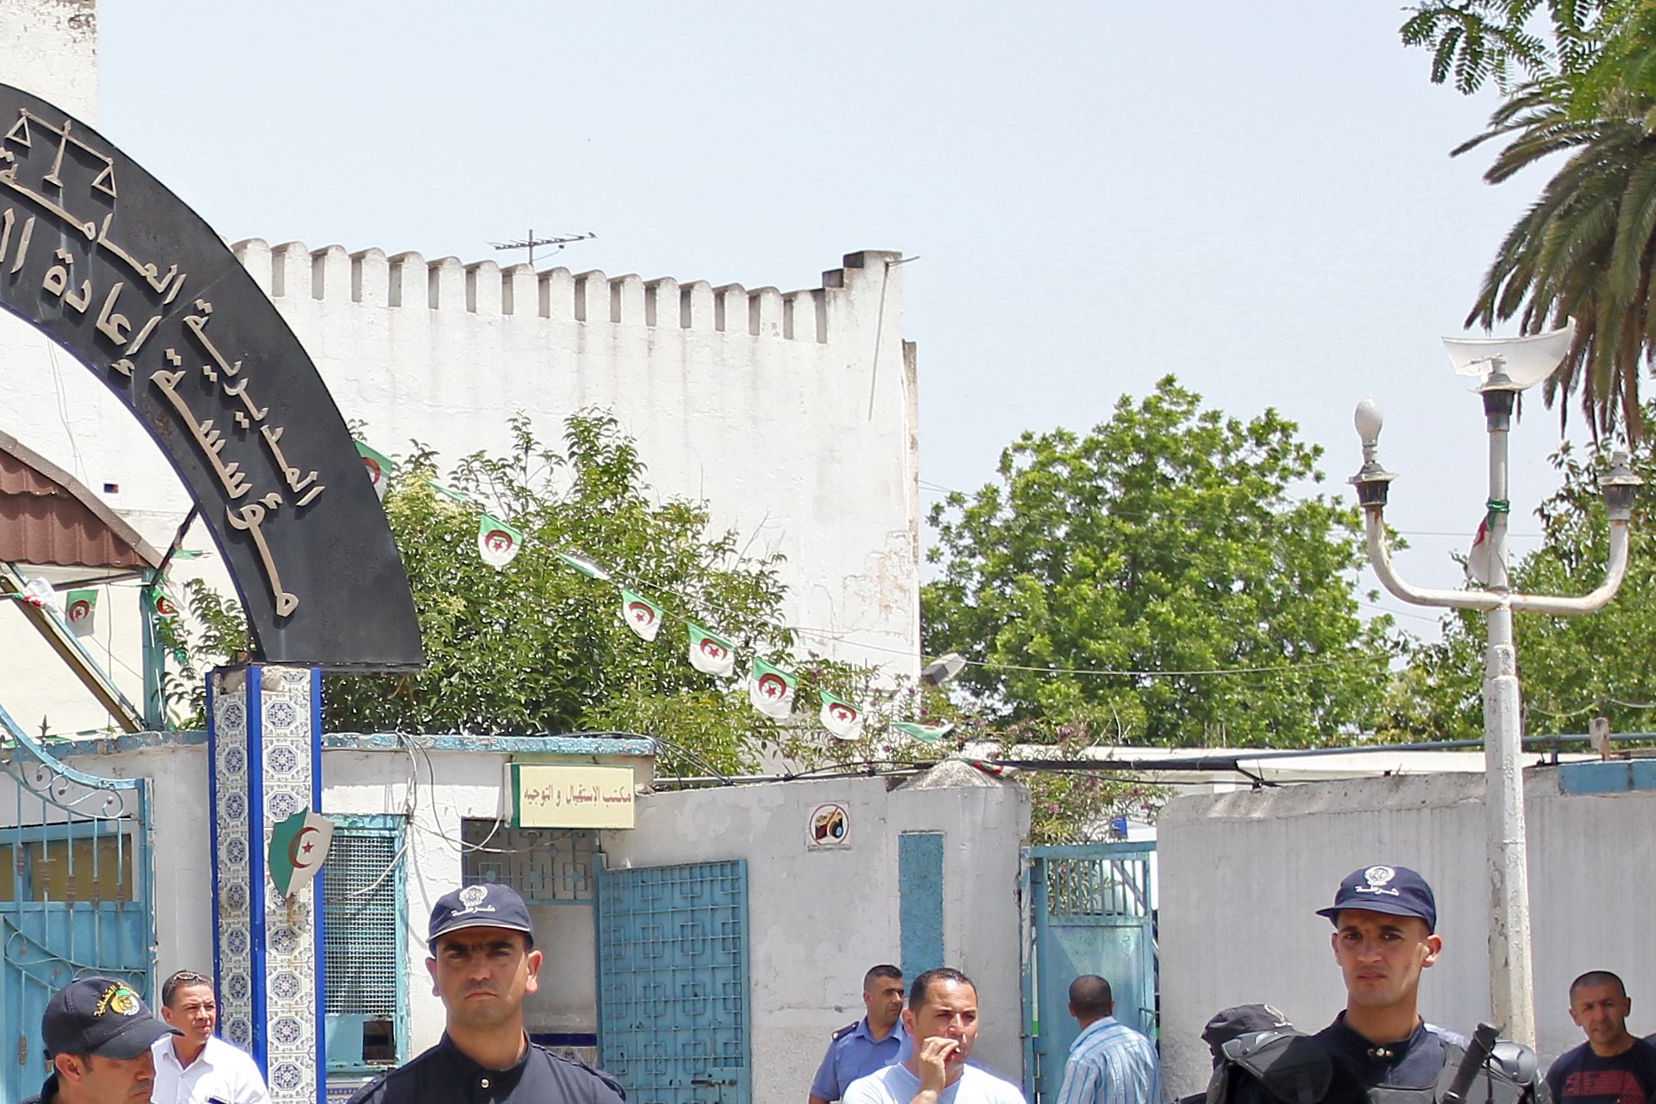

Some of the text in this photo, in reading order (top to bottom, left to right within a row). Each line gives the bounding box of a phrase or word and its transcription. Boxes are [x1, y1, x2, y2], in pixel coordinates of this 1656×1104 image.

[43, 248, 163, 376] إعادة
[185, 299, 325, 507] المديرية
[150, 348, 299, 617] مؤسسة
